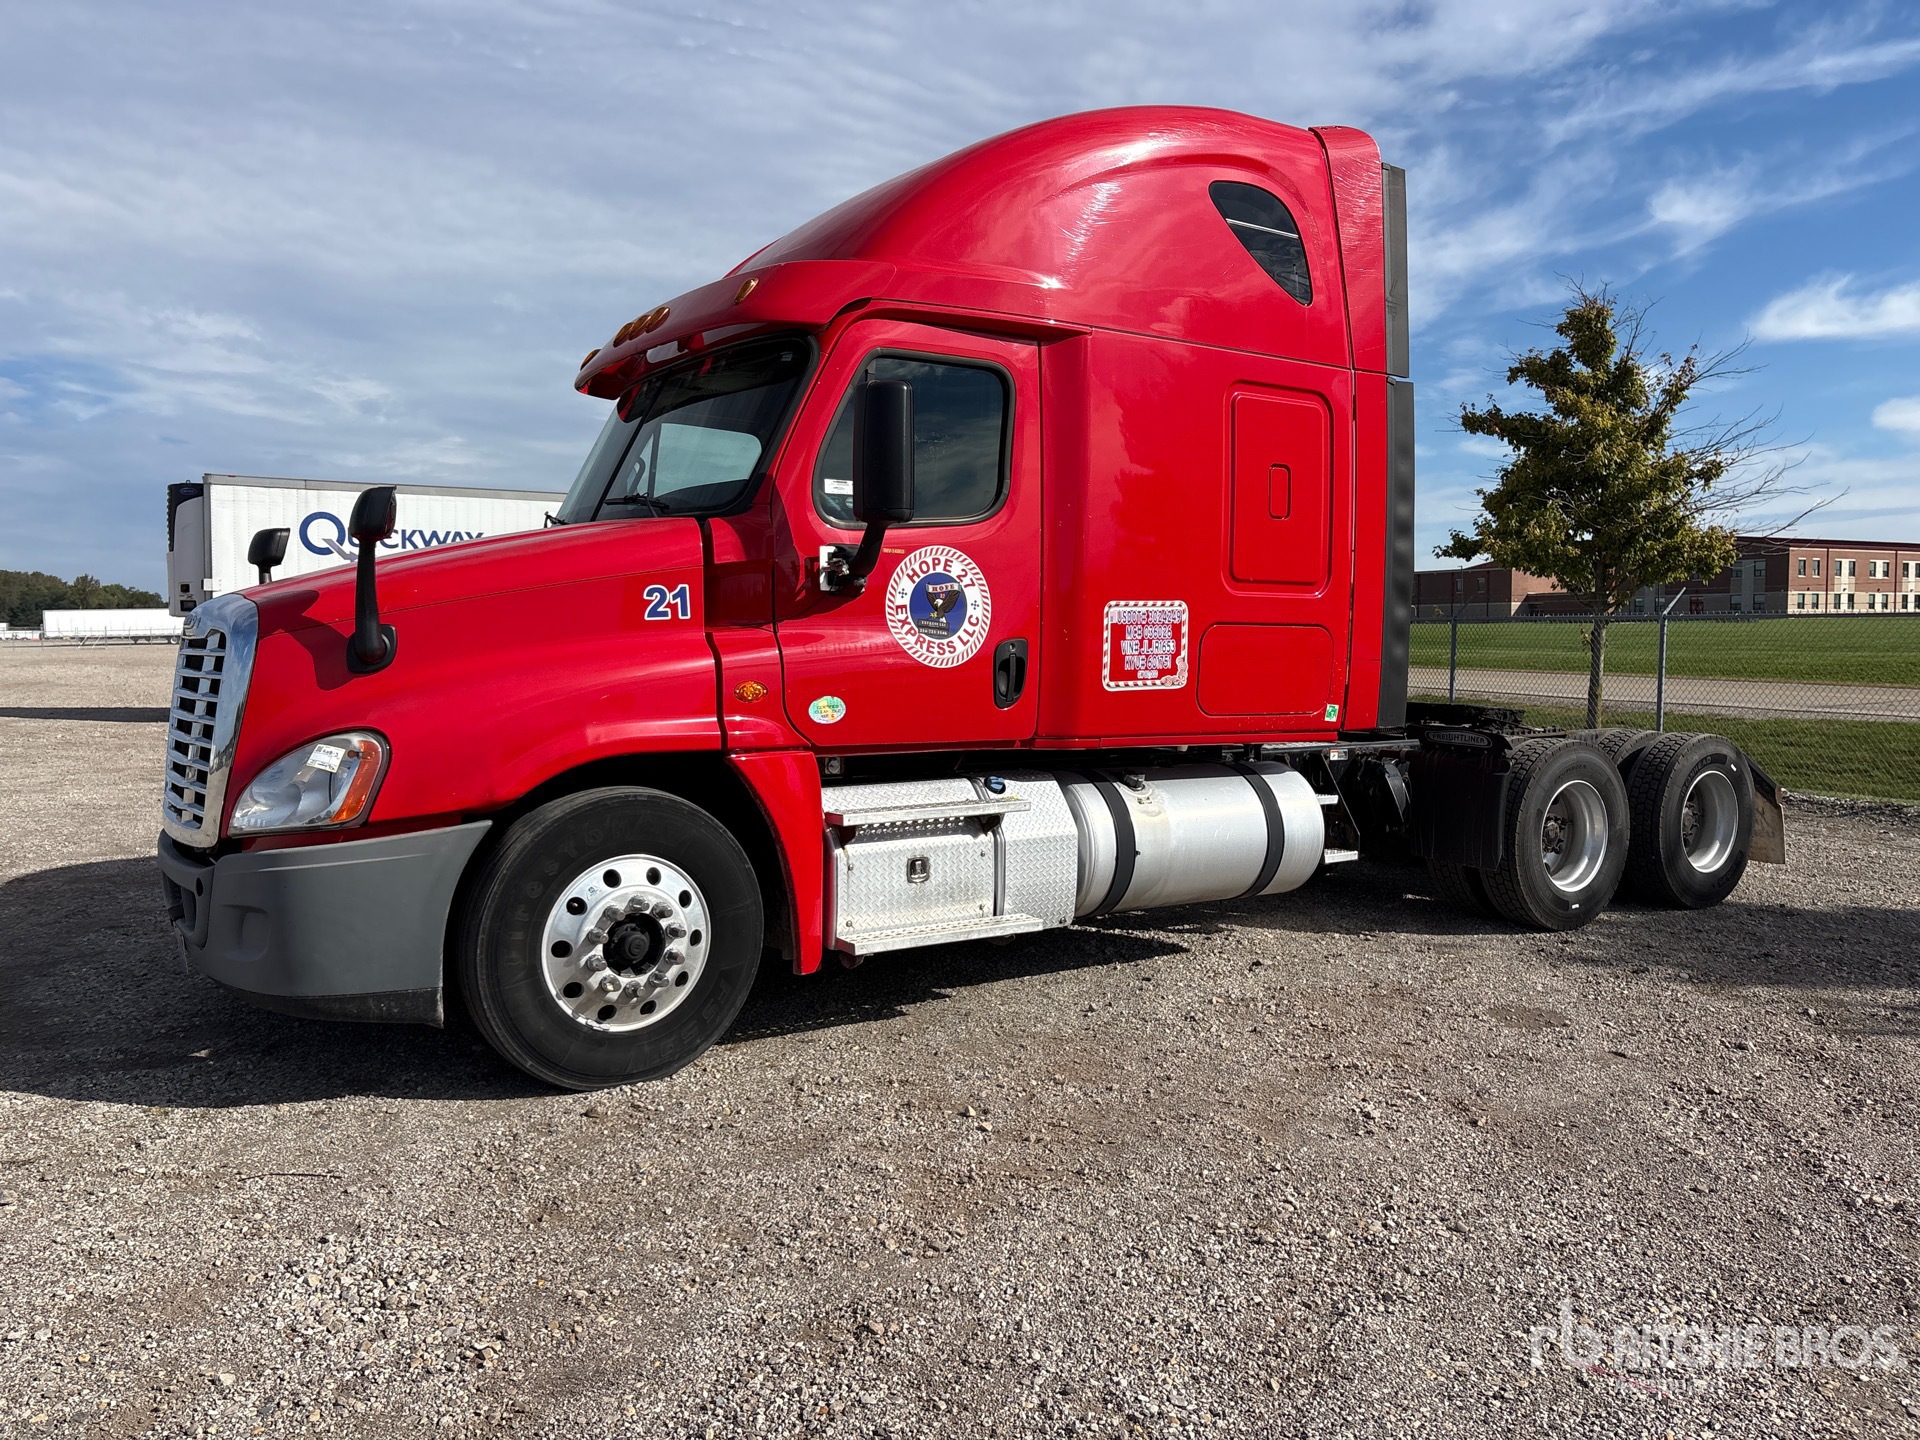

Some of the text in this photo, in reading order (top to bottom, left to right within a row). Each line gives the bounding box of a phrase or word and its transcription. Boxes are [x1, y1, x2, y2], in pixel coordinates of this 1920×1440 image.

[906, 557, 976, 588] HOPE 27
[643, 584, 691, 620] 21
[931, 585, 955, 593] HOPE
[895, 604, 979, 655] EXPRESS LLC
[1432, 733, 1486, 744] FREIGHTLINER
